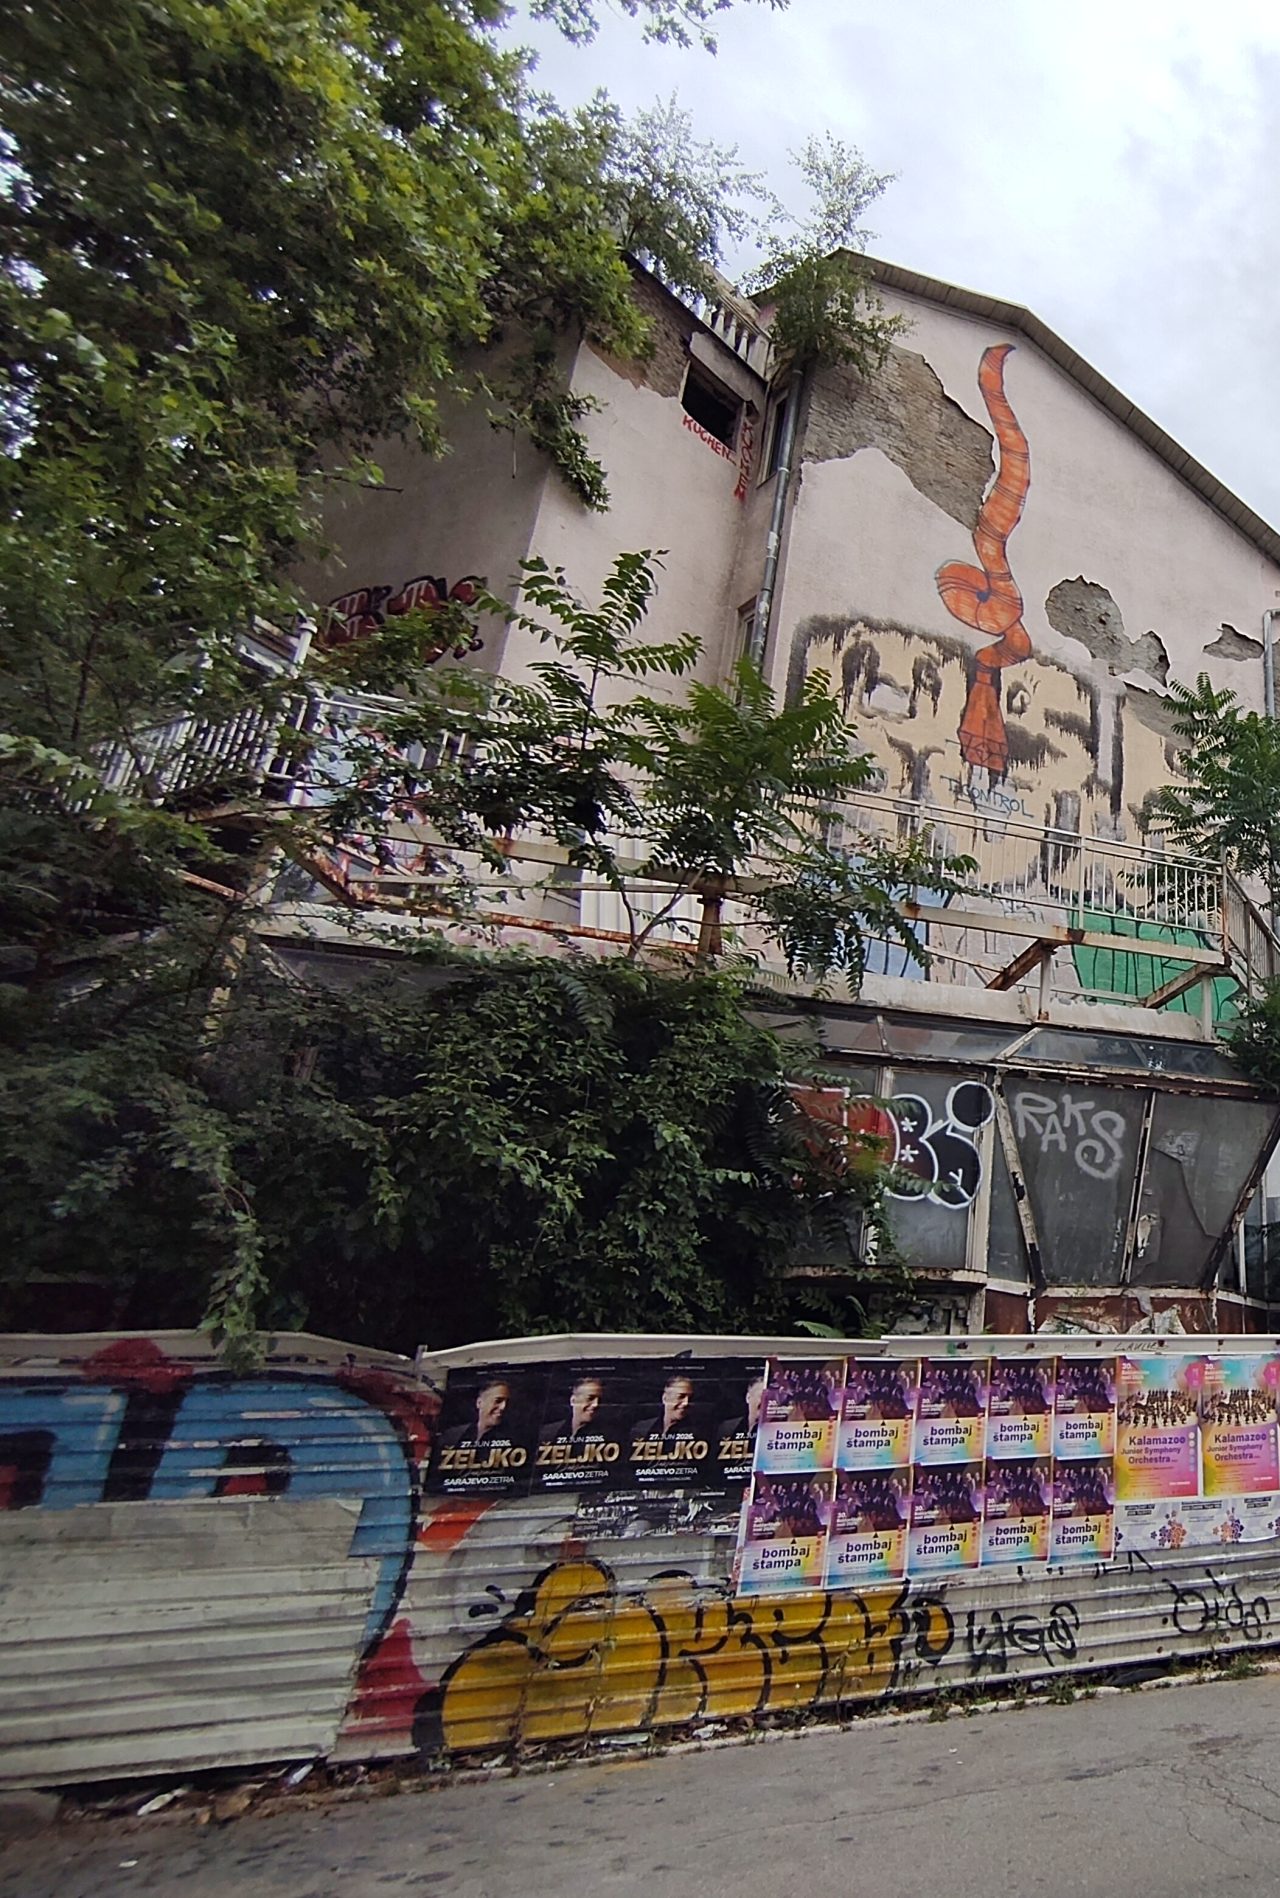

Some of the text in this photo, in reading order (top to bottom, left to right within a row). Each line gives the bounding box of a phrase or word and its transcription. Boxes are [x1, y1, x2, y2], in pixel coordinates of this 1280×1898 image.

[1015, 1092, 1126, 1179] RAKS
[931, 1424, 972, 1437] bombaj
[1000, 1421, 1039, 1434] bombaj
[1066, 1419, 1103, 1431] bombaj
[776, 1428, 822, 1440] bombaj
[855, 1427, 898, 1439] bombaj
[993, 1432, 1033, 1443] štampa
[1059, 1430, 1097, 1441] štampa
[1214, 1432, 1267, 1443] Kalamazoo
[767, 1439, 814, 1451] štampa
[846, 1438, 890, 1450] štampa
[923, 1435, 965, 1447] štampa
[1129, 1435, 1186, 1446] Kalamazoo
[535, 1441, 620, 1466] ŽELJKO
[629, 1437, 709, 1461] ŽELJKO
[717, 1437, 753, 1460] ŽEL
[1144, 1447, 1181, 1455] Symphony
[1207, 1443, 1263, 1453] Junior Symphony
[438, 1445, 527, 1470] ŽELJKO
[1128, 1456, 1171, 1464] Orchestra
[1214, 1452, 1254, 1462] Orchestra
[542, 1470, 609, 1480] SARAJEVO ZETRA
[635, 1467, 698, 1476] SARAJEVO ZETRA
[443, 1475, 515, 1486] SARAJEVO ZETRA
[996, 1522, 1037, 1536] bombaj
[1062, 1522, 1101, 1535] bombaj
[924, 1529, 967, 1545] bombaj
[988, 1535, 1030, 1546] štampa
[1055, 1534, 1095, 1545] štampa
[846, 1538, 892, 1553] bombaj
[916, 1543, 960, 1555] štampa
[762, 1546, 810, 1559] bombaj
[838, 1552, 883, 1564] štampa
[753, 1558, 801, 1570] štampa
